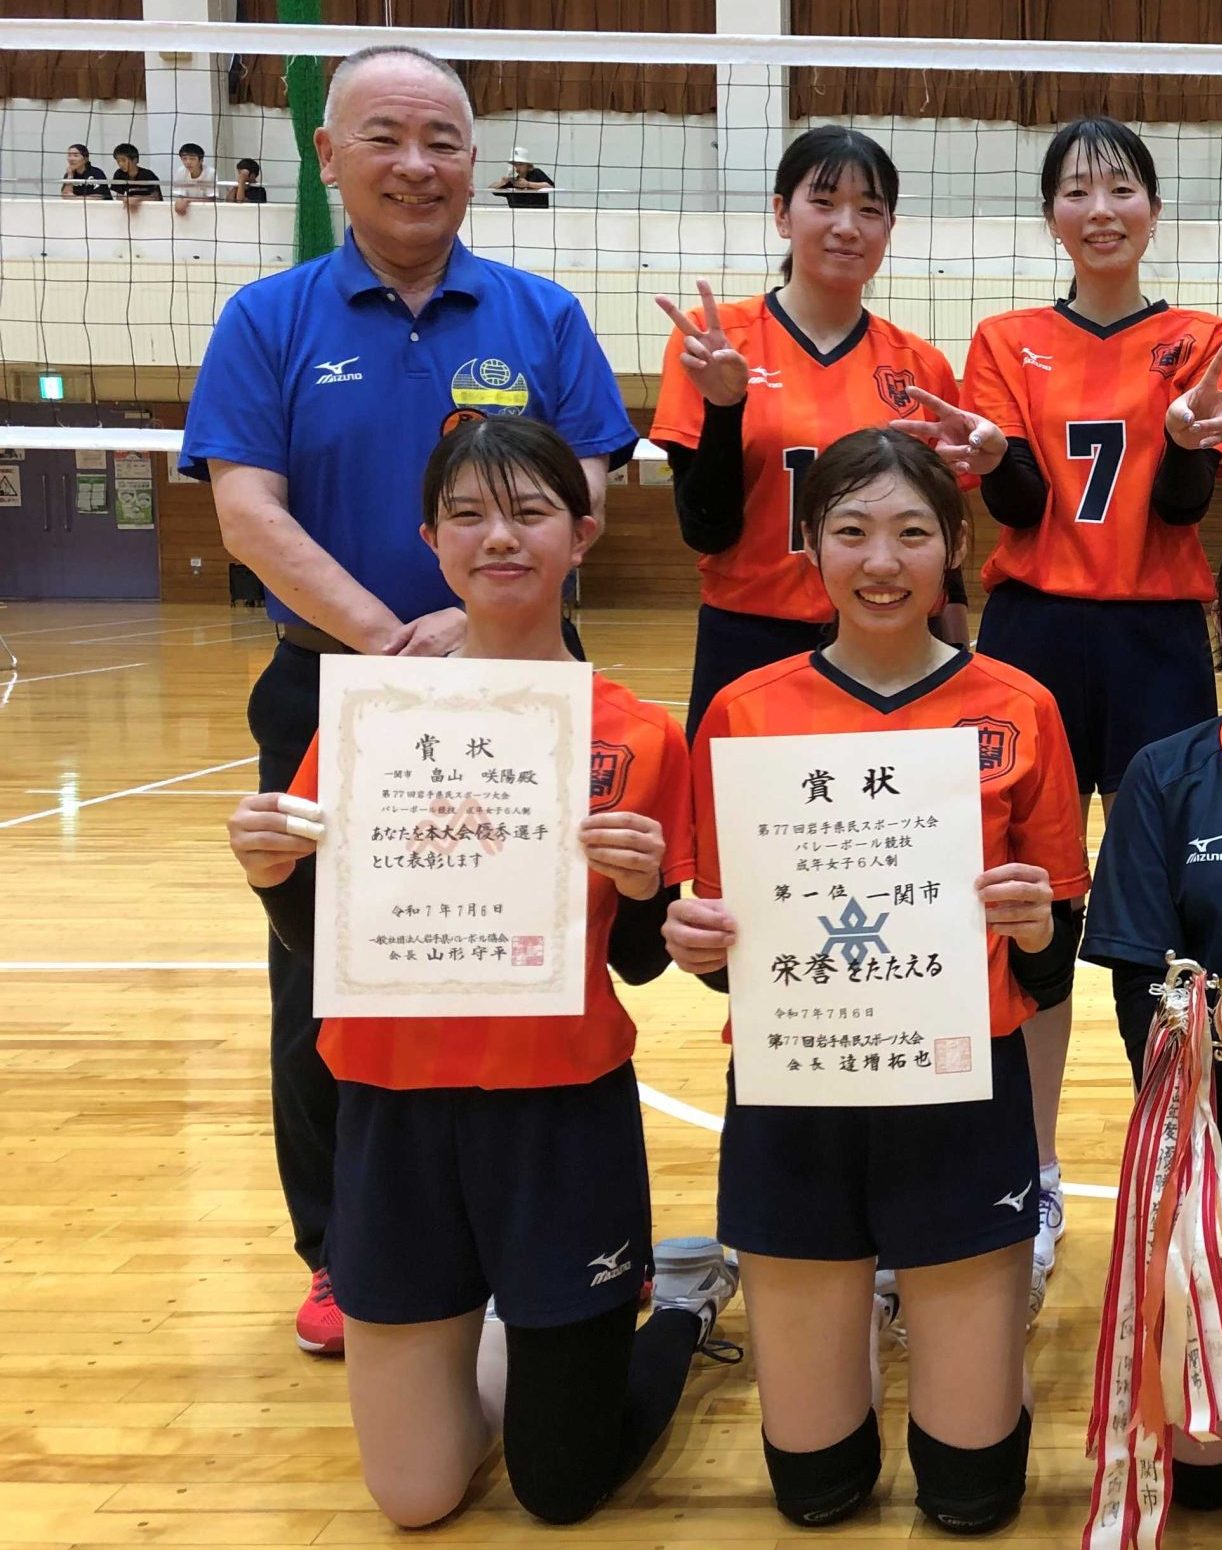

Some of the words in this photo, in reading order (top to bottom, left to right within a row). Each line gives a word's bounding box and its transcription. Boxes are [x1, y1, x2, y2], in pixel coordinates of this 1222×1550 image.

[315, 373, 363, 384] MIZUNO
[1065, 420, 1126, 524] 7
[415, 733, 495, 762] 賞状
[430, 768, 463, 784] 畠山
[801, 765, 901, 805] 賞状
[371, 823, 550, 842] あなたを本大会優秀選手
[758, 815, 939, 837] 第77回岩手県民スポーツ大会
[794, 836, 913, 852] バレーボール競技
[371, 851, 483, 870] として表彰します
[795, 855, 899, 872] 成年女子6人制
[773, 883, 849, 903] 第一位
[866, 879, 941, 906] 一関市
[391, 903, 504, 918] 令和7年7月6日
[427, 945, 508, 963] 山形守平
[770, 952, 944, 987] 栄誉をたたえる
[774, 1007, 875, 1020] 令和7年7月6日
[768, 1030, 925, 1050] 第77回岩手県民スポーツ大会
[787, 1058, 825, 1072] 会長
[839, 1050, 932, 1073] 達増拓也
